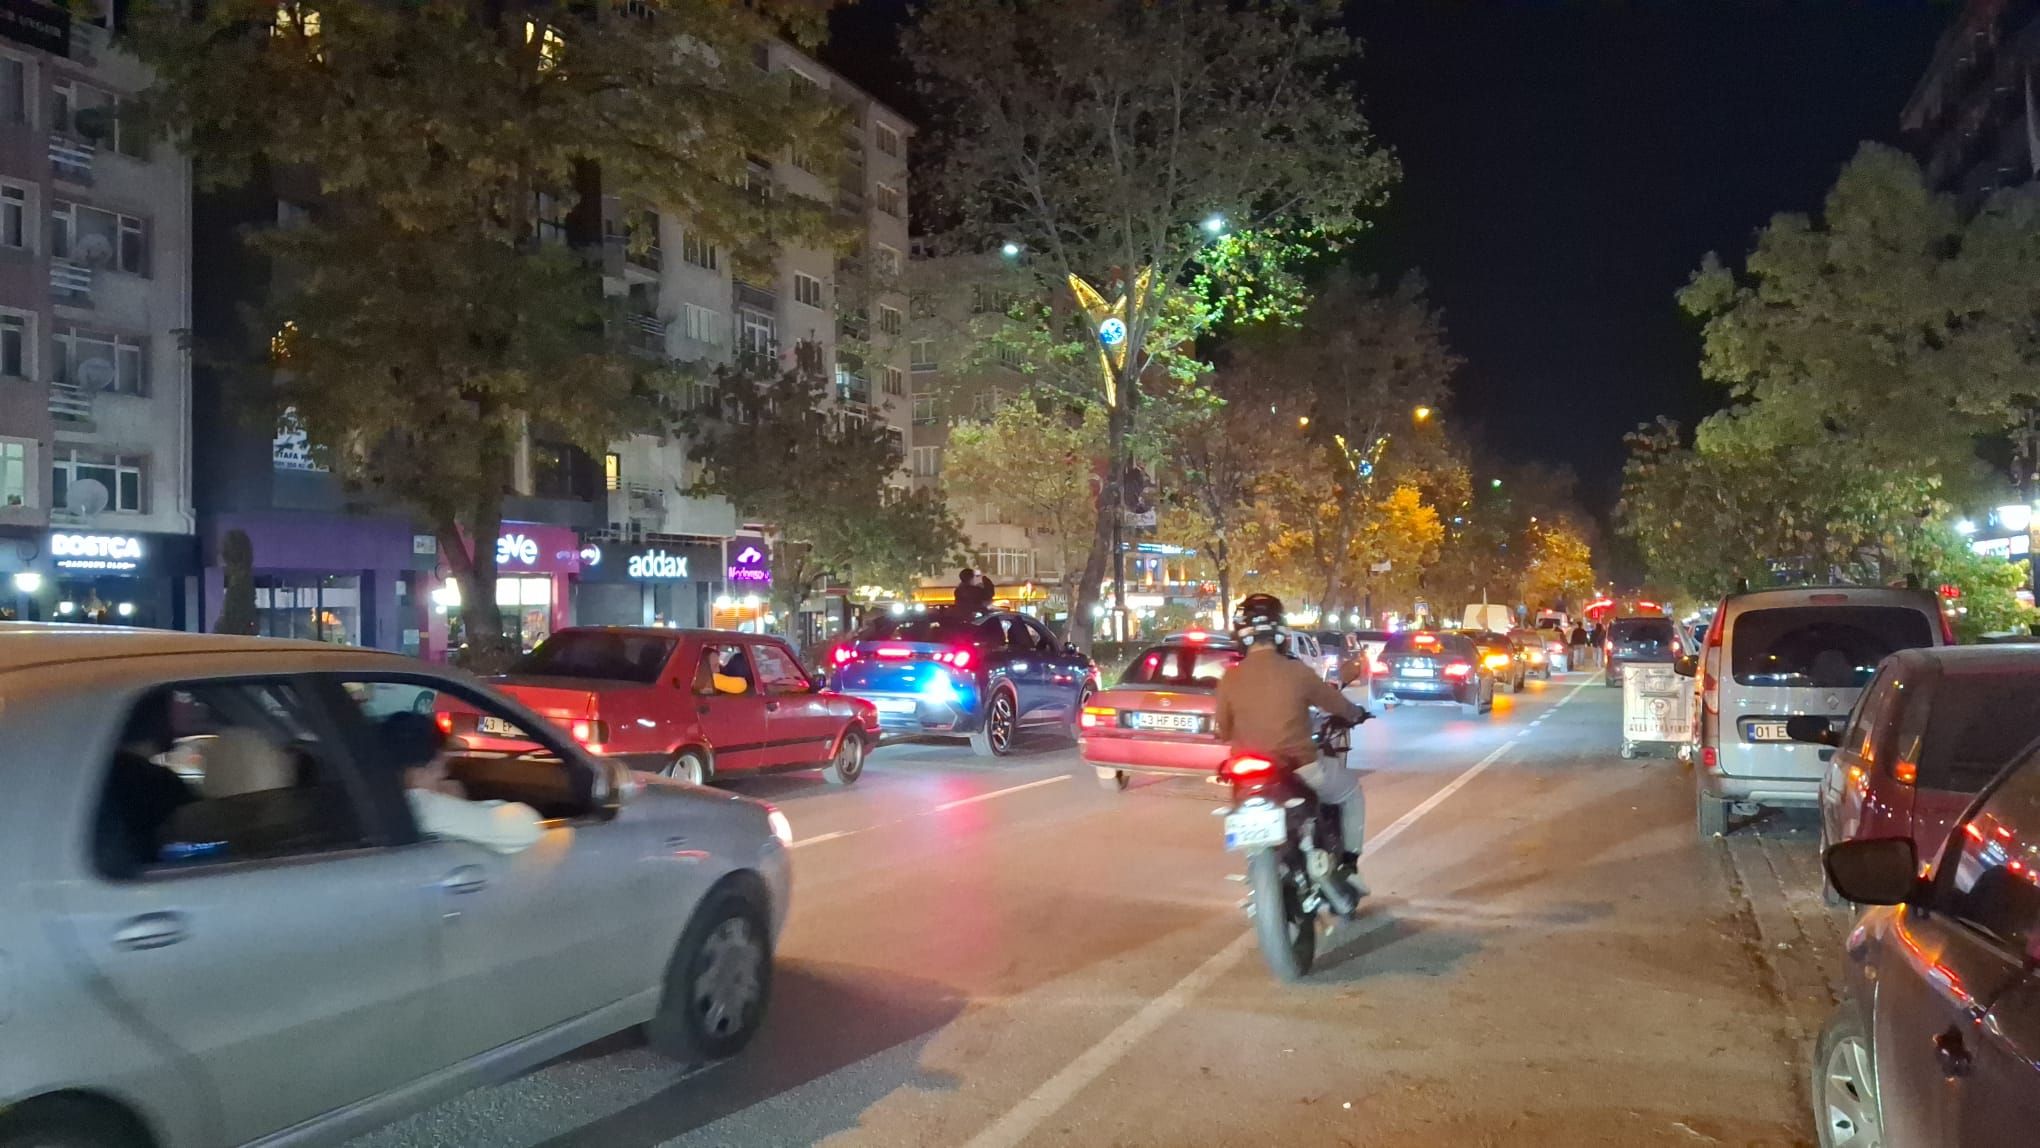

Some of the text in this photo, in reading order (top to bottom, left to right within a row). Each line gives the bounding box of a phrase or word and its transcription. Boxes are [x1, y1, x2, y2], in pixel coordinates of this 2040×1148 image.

[52, 533, 141, 559] DOSTÇA
[629, 549, 688, 577] addax
[484, 718, 496, 730] 43
[1755, 726, 1770, 738] 01
